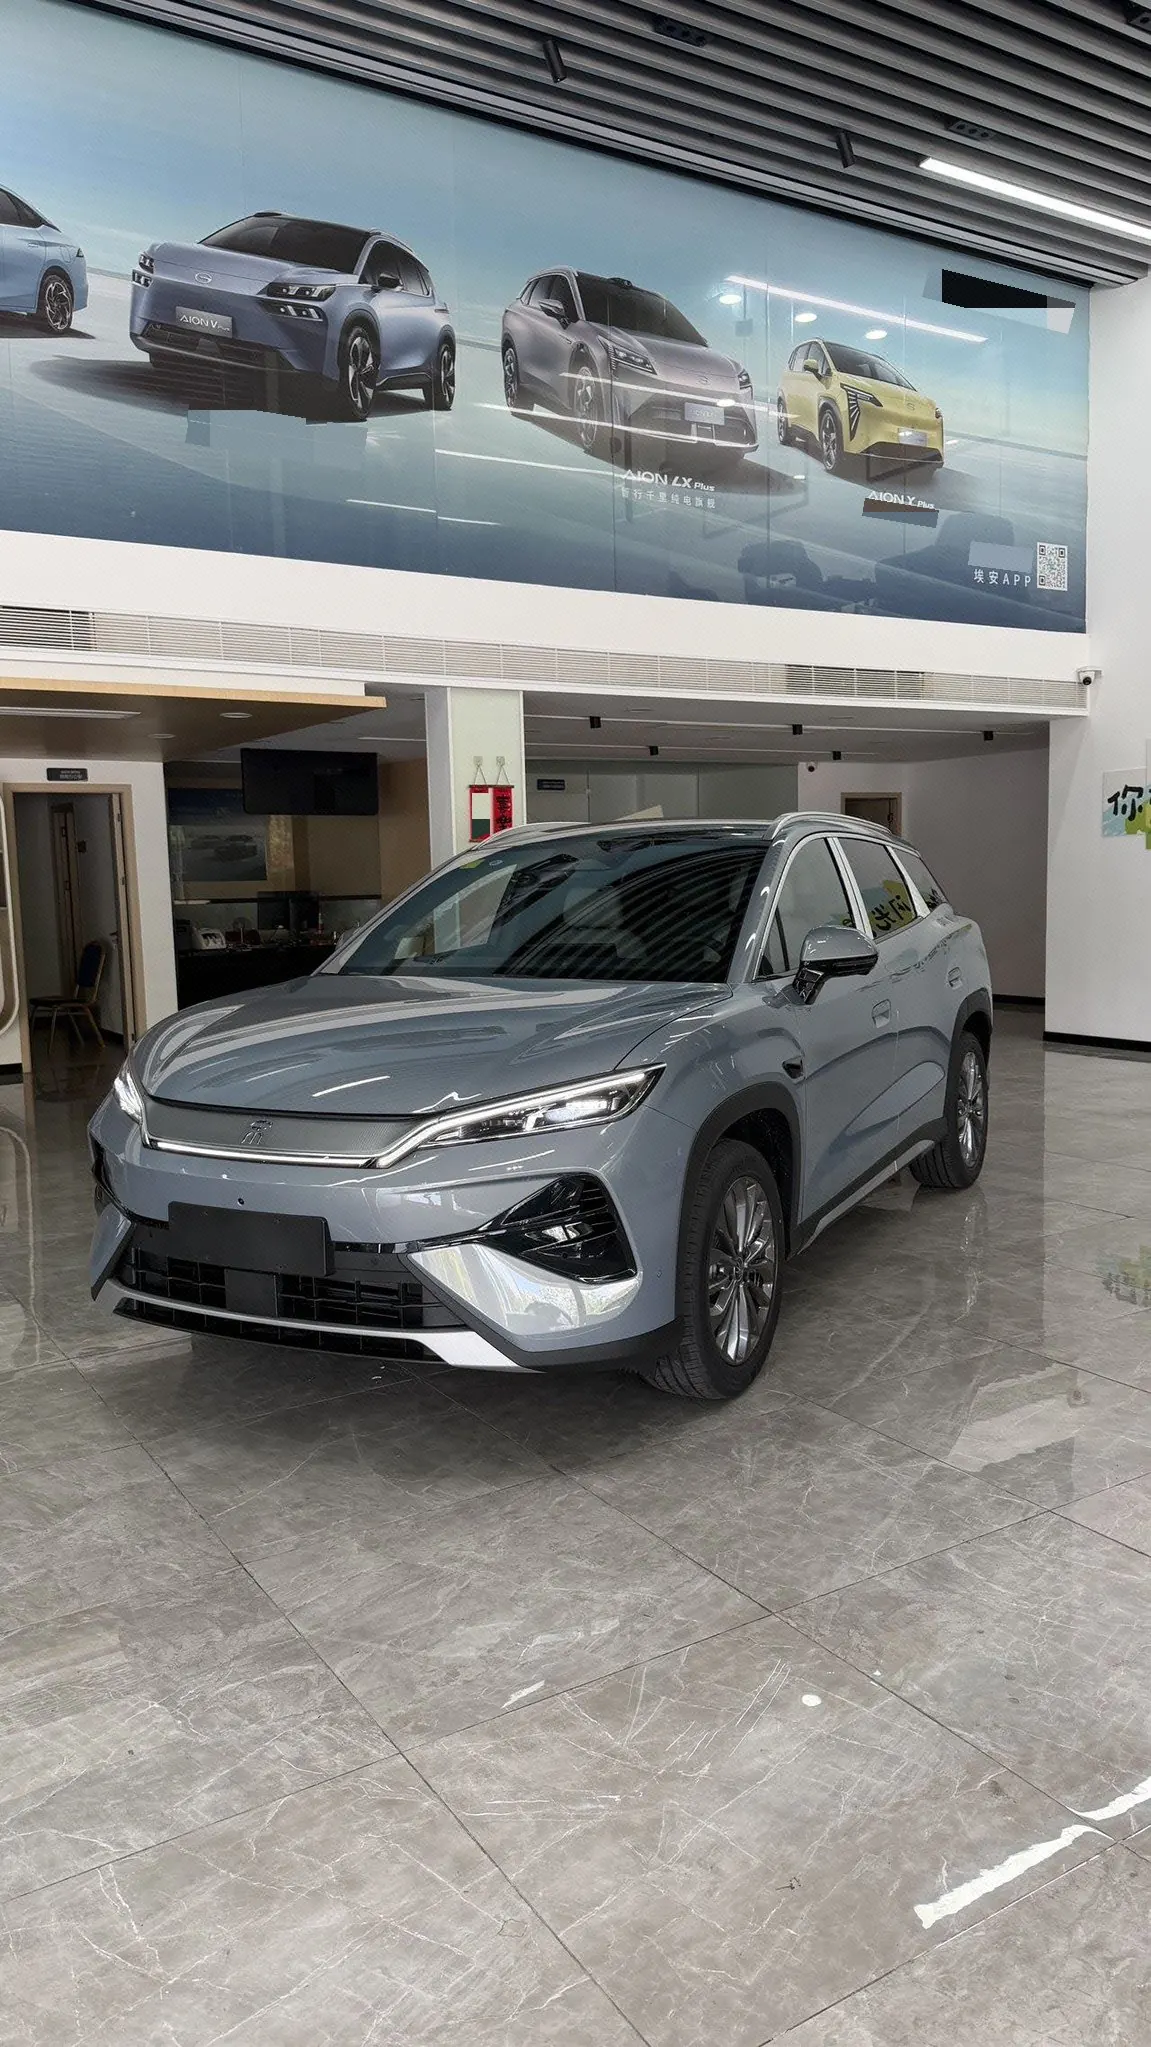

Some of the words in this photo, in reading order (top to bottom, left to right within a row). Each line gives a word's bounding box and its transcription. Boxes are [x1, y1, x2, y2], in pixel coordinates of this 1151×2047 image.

[180, 314, 209, 327] AION
[210, 319, 218, 328] V
[623, 469, 668, 486] AION
[671, 476, 693, 489] LX
[693, 482, 716, 493] Plus
[868, 490, 905, 505] AION
[906, 495, 916, 507] Y
[917, 500, 935, 509] Plus
[973, 568, 1032, 588] 埃安APP
